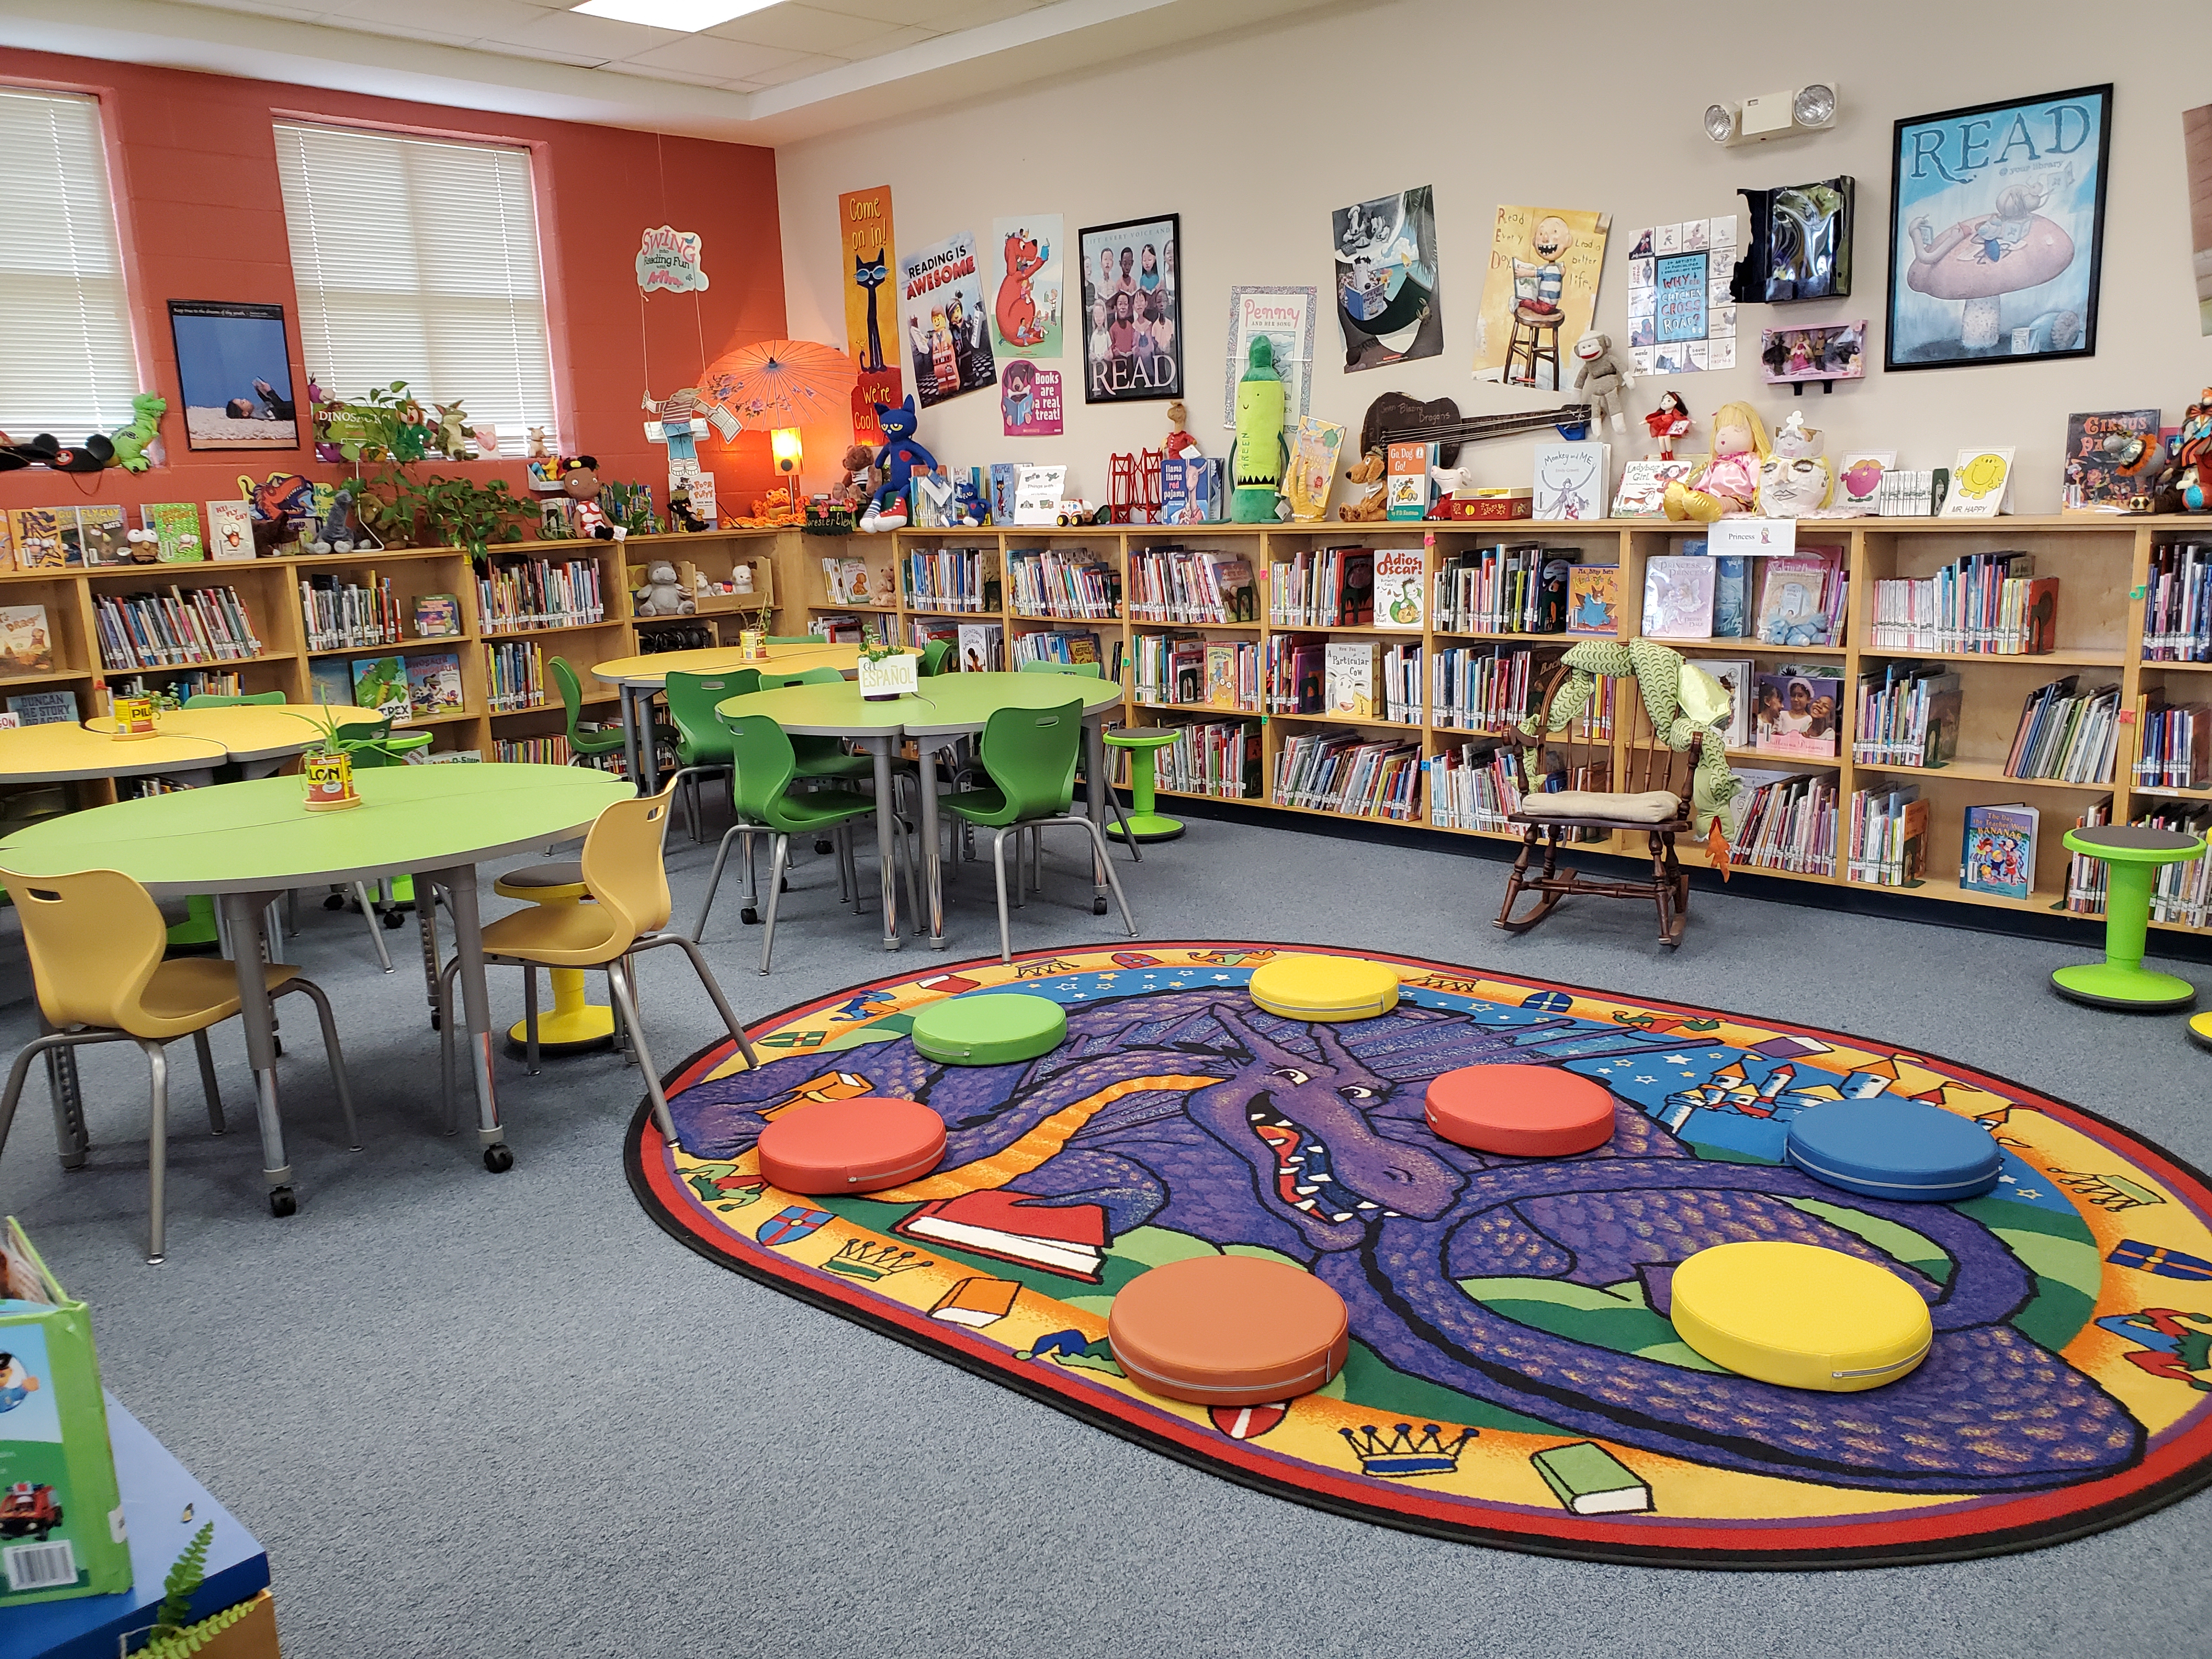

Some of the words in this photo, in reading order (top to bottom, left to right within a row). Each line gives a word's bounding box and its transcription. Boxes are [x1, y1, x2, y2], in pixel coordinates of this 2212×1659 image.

[1911, 105, 2091, 184] READ
[2009, 165, 2030, 175] your
[2033, 160, 2064, 171] library
[850, 198, 881, 221] Come
[1498, 207, 1524, 225] Read
[853, 230, 865, 250] on
[871, 218, 887, 247] in!
[1105, 233, 1127, 242] EVERY
[1131, 229, 1153, 238] VOICE
[642, 229, 695, 263] SWING
[673, 256, 690, 269] Fun
[908, 252, 954, 279] READING
[955, 245, 967, 259] IS
[1572, 254, 1597, 264] better
[906, 255, 976, 300] AWESOME
[1663, 273, 1690, 289] WHY
[1662, 289, 1702, 302] CHICKEN
[1244, 298, 1300, 329] Penny
[1662, 300, 1701, 316] CROSS
[1663, 314, 1701, 335] ROAD?
[1035, 372, 1059, 385] Books
[1092, 354, 1176, 395] READ
[862, 382, 890, 404] We're
[1040, 386, 1054, 396] are
[1035, 399, 1040, 409] a
[1042, 396, 1060, 409] real
[855, 408, 873, 431] Cool
[1035, 408, 1060, 420] treat!
[1419, 413, 1450, 425] Dragons
[2084, 416, 2147, 435] CIRCUS
[1242, 433, 1250, 470] GREEN
[1544, 451, 1569, 466] Monkey
[1579, 452, 1594, 465] ME
[1166, 465, 1182, 473] llama
[1395, 461, 1406, 471] Go!
[1166, 473, 1182, 481] llama
[1169, 481, 1180, 489] red
[1164, 489, 1185, 500] pajama
[81, 509, 99, 518] FLY
[99, 508, 120, 517] GUY
[216, 505, 228, 514] HI!
[225, 509, 238, 517] FLY
[235, 512, 247, 521] GUY
[103, 521, 121, 530] BATS
[1728, 533, 1755, 541] Princess
[1376, 560, 1423, 575] Oscar!
[1660, 561, 1700, 571] PRINCESS
[1669, 569, 1709, 578] PRINCESS
[2129, 585, 2147, 599] J
[864, 662, 877, 672] en
[1333, 656, 1369, 665] Particular
[412, 663, 459, 678] DINOSAUR
[862, 665, 913, 687] ESPAÑOL
[1350, 667, 1362, 676] Cow
[21, 694, 64, 707] DUNCAN
[17, 708, 36, 719] THE
[38, 704, 70, 715] STORY
[2118, 709, 2132, 723] K
[1420, 761, 1430, 771] H
[1985, 819, 2008, 828] Teacher
[2011, 823, 2027, 831] Went
[2002, 815, 2013, 823] Day
[1978, 827, 2022, 840] BANANAS
